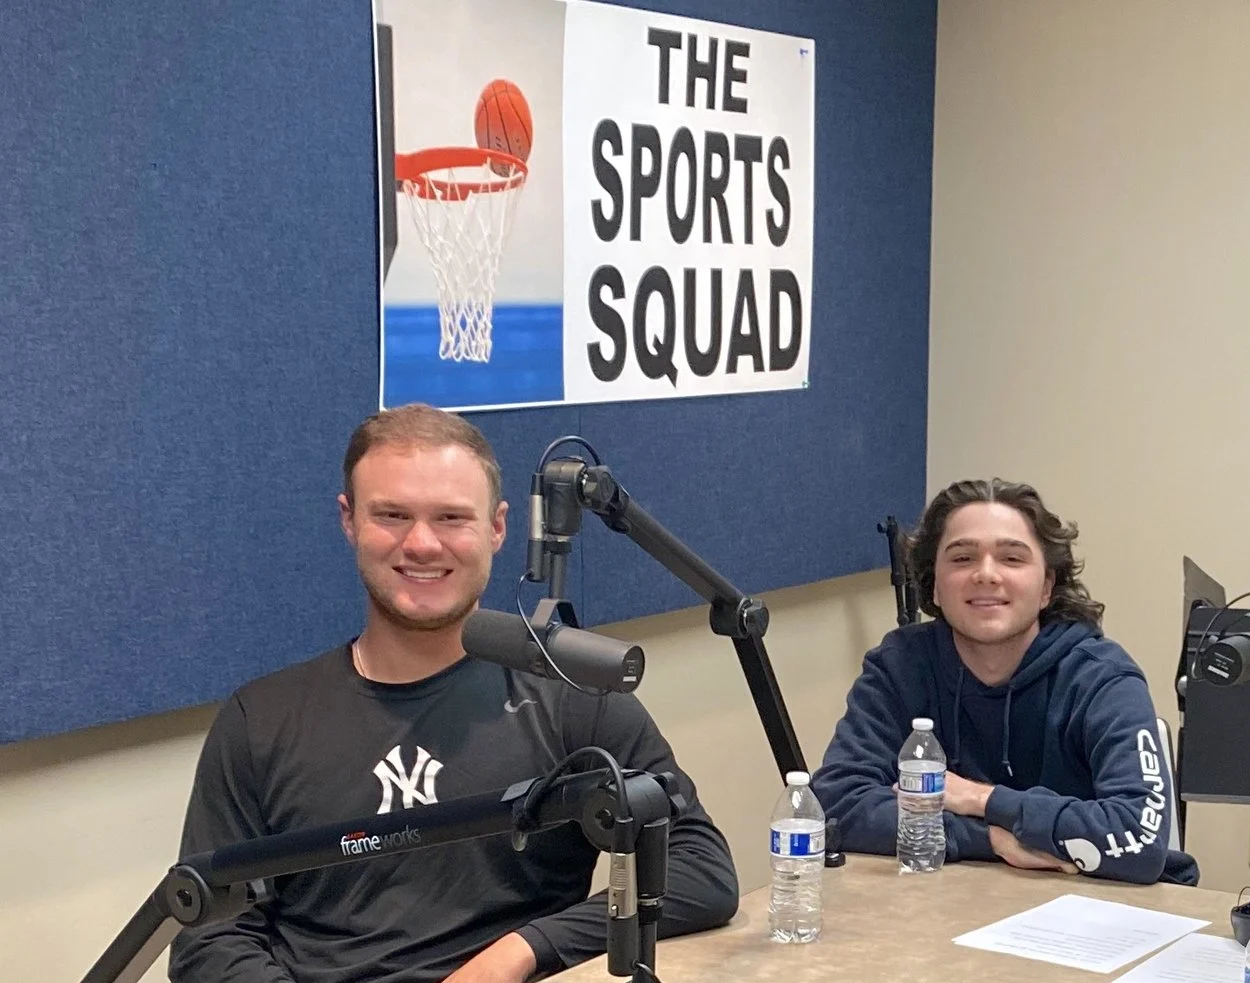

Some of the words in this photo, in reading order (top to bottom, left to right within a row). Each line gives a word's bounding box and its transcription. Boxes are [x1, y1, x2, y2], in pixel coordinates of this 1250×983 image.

[647, 26, 751, 114] THE
[590, 118, 792, 247] SPORTS
[586, 264, 801, 388] SQUAD
[373, 745, 444, 814] NY
